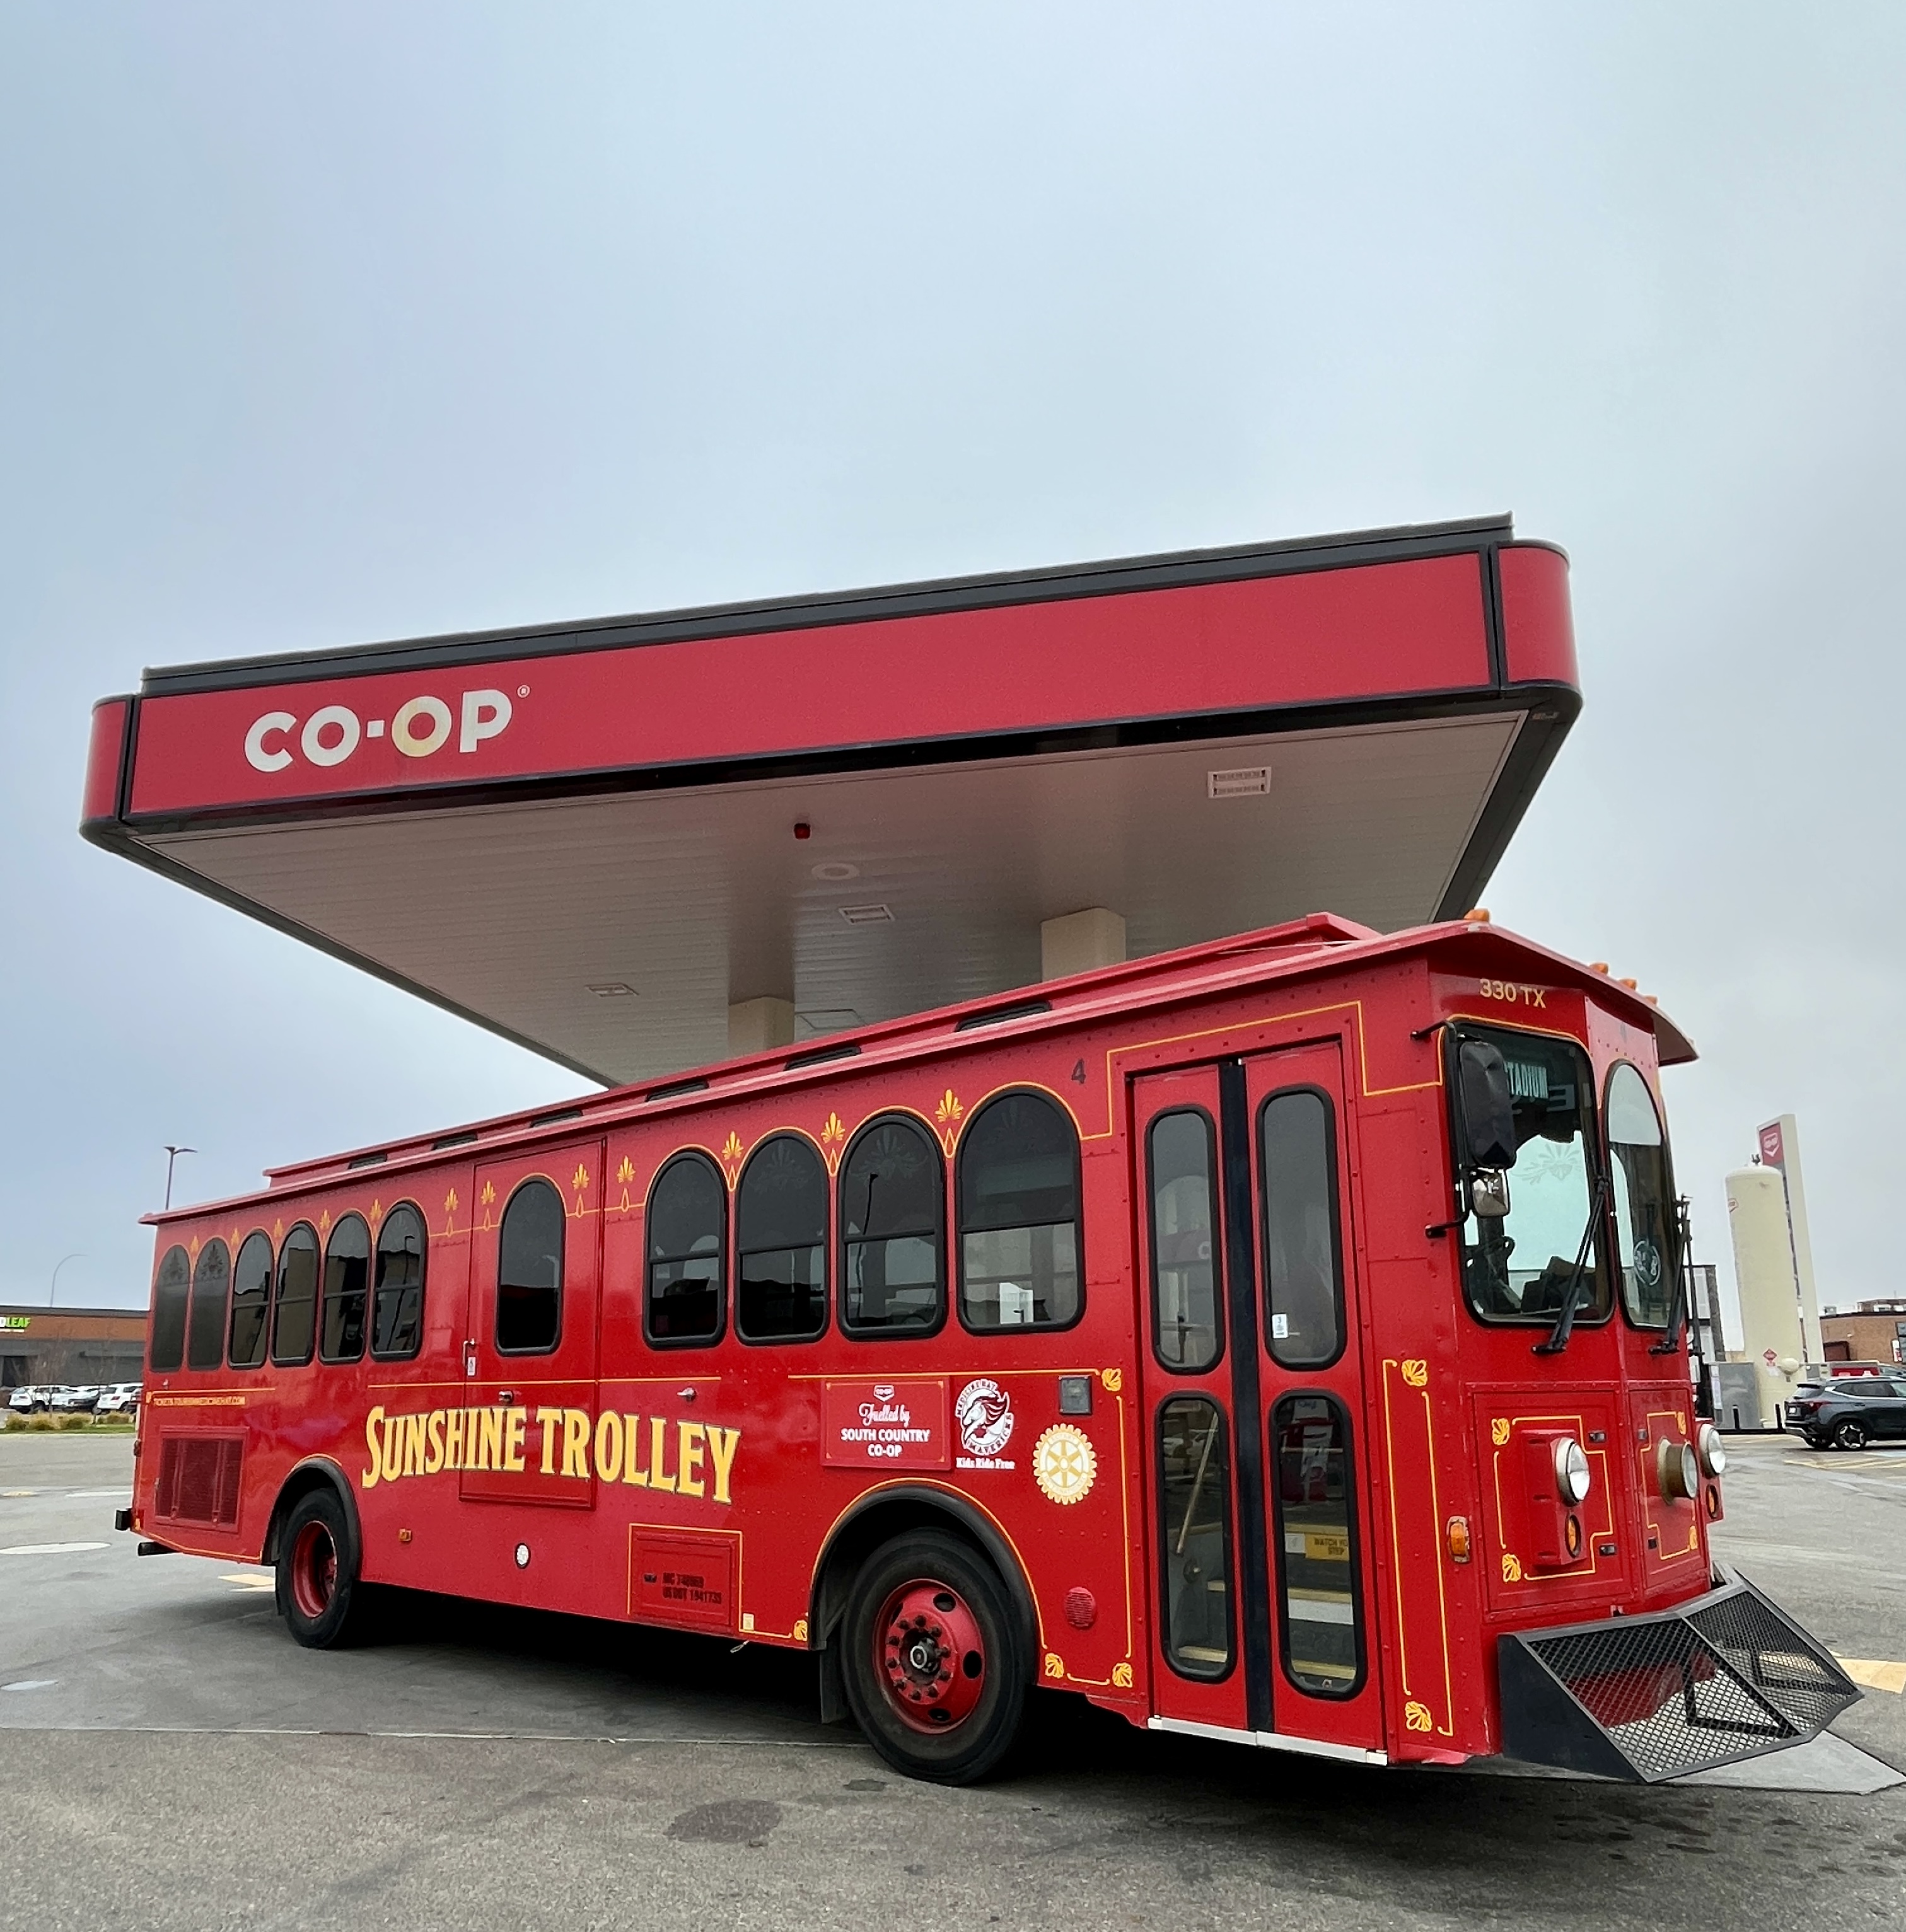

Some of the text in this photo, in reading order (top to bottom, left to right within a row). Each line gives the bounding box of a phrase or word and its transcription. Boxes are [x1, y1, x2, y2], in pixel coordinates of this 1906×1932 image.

[244, 689, 513, 772] CO-OP
[1480, 978, 1547, 1009] 330 TX
[1071, 1058, 1086, 1084] 4
[859, 1403, 910, 1428] Fuelled by
[840, 1428, 931, 1442] SOUTH COUNTRY
[362, 1405, 741, 1505] SUNSHINE TROLLEY
[867, 1443, 902, 1457] CO-OP
[956, 1457, 1016, 1470] Kids Ride Free
